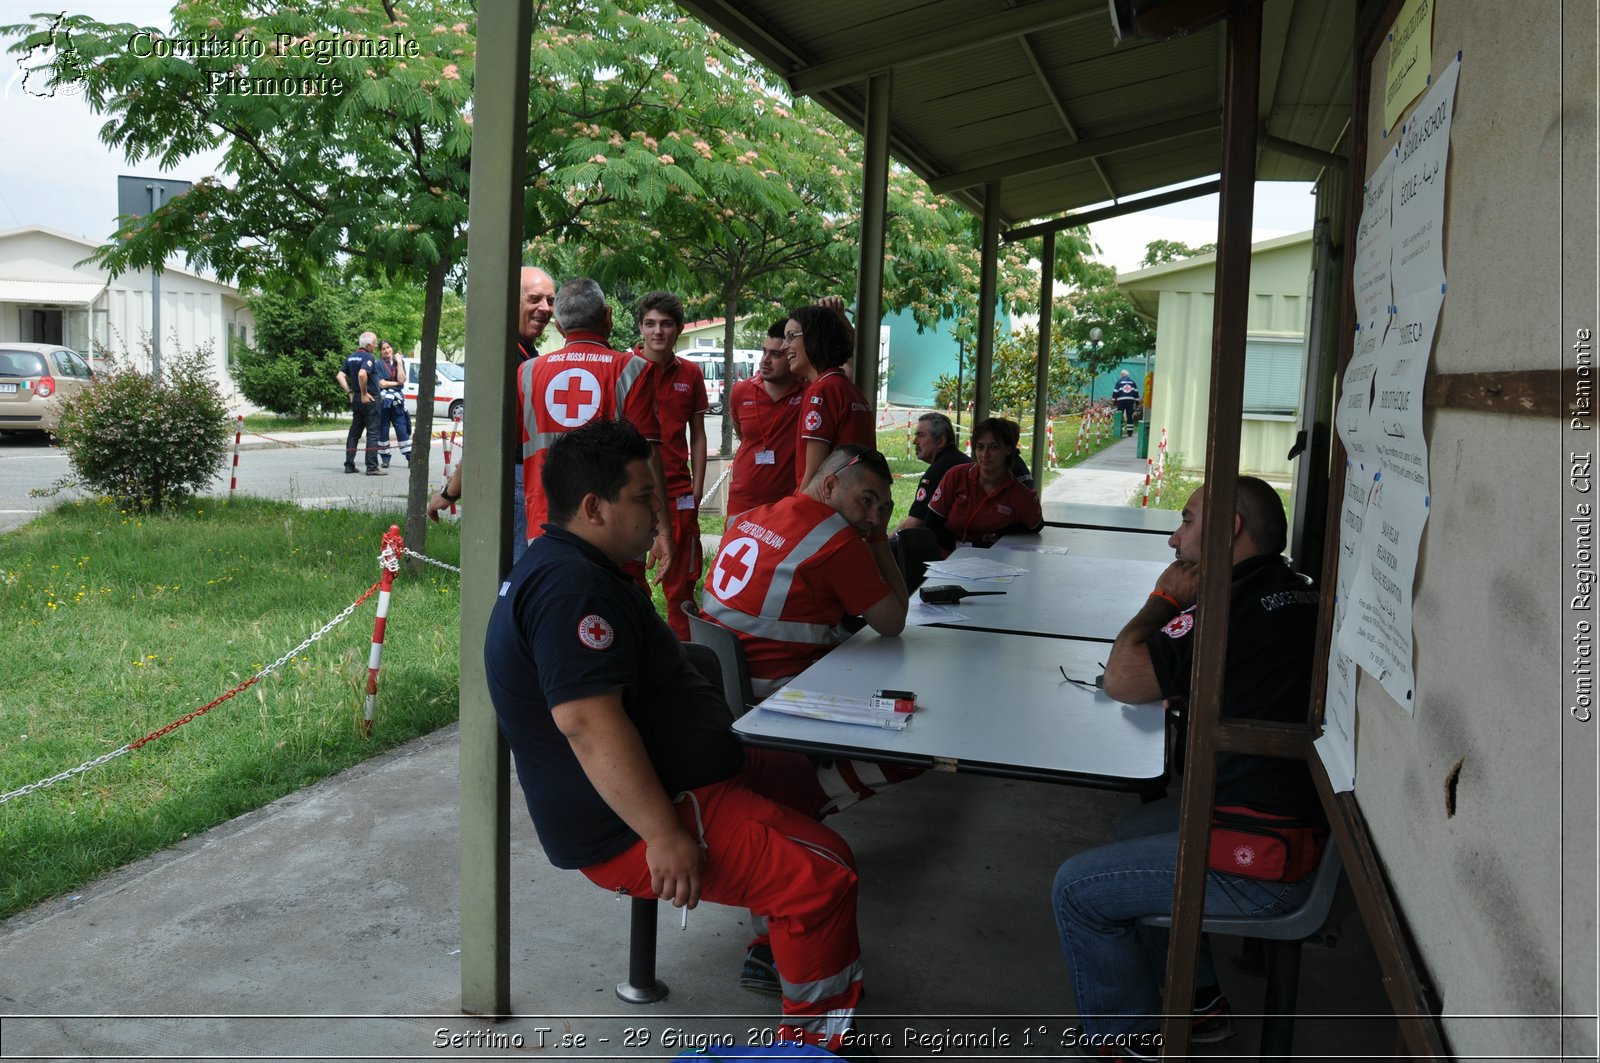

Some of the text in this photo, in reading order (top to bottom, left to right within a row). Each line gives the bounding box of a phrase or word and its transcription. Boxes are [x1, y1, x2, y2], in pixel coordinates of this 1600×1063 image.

[566, 352, 585, 362] ROSSA
[586, 353, 613, 363] ITALIANA
[761, 529, 786, 550] ITALIANA
